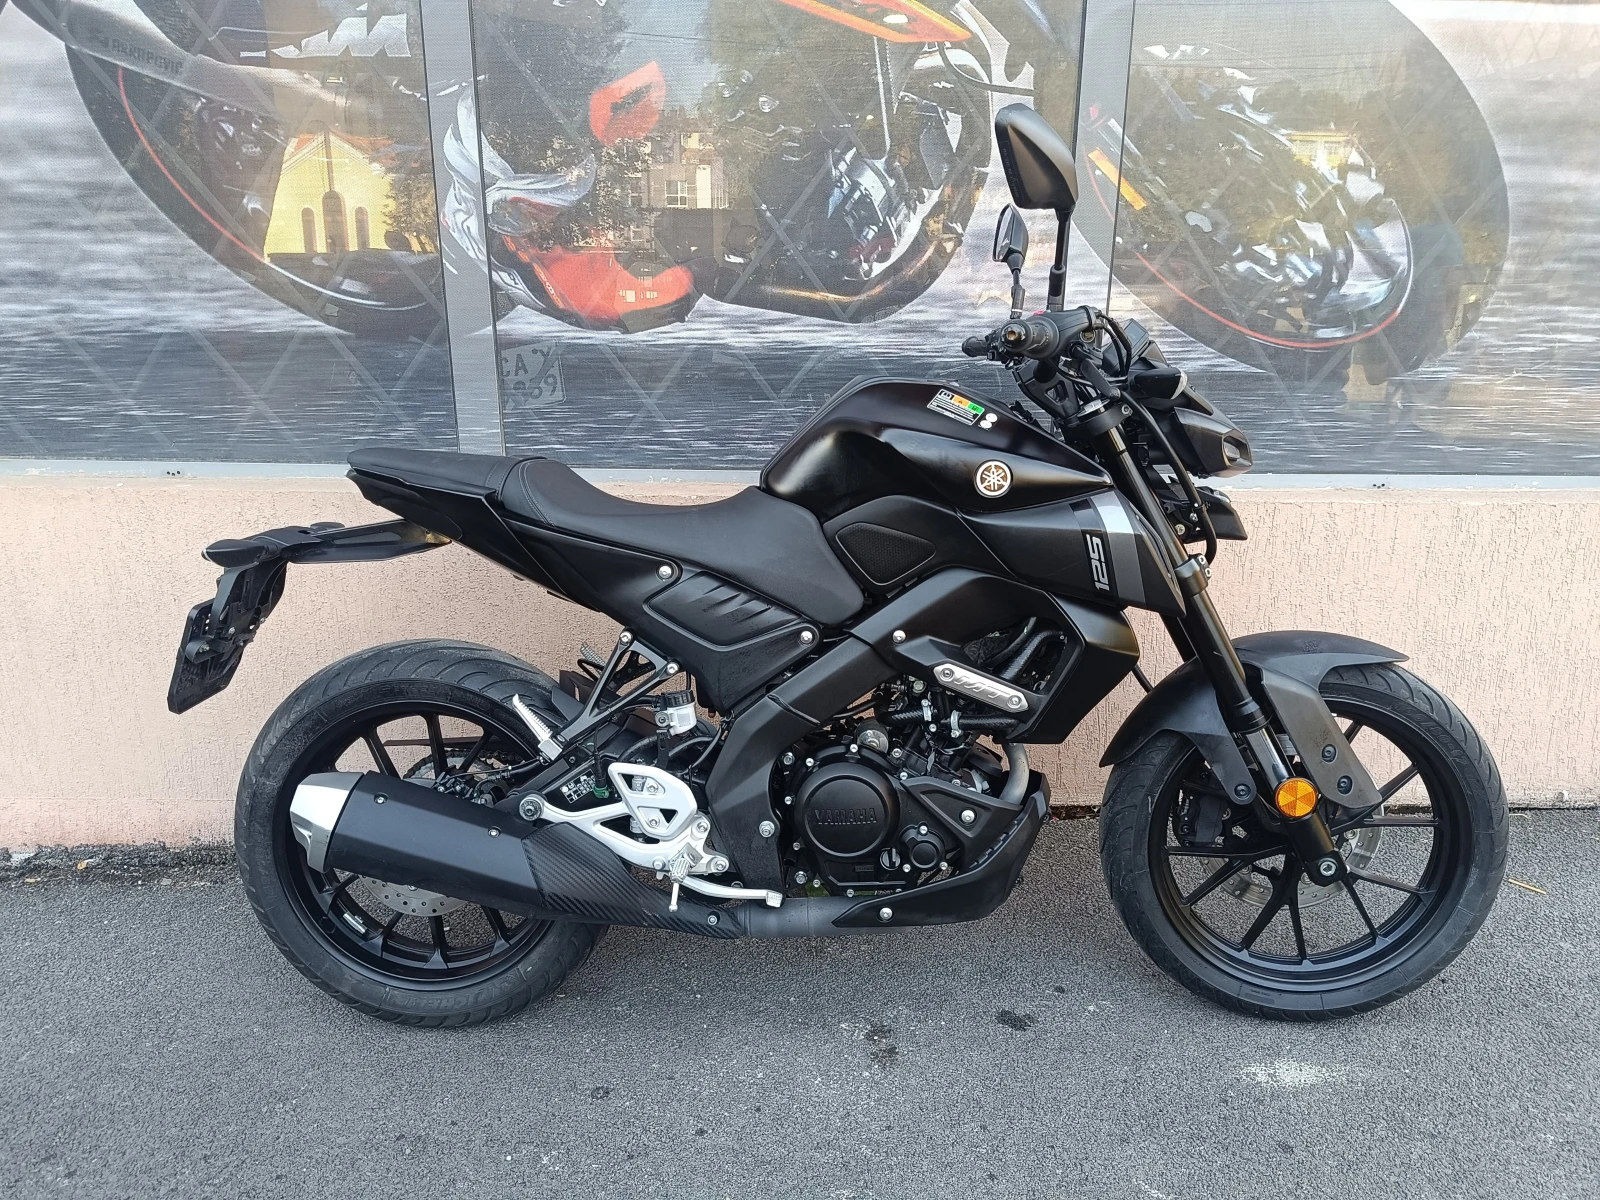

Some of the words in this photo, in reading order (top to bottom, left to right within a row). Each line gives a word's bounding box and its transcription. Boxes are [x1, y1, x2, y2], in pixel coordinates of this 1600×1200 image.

[1085, 533, 1110, 591] 125
[953, 675, 1011, 699] MT
[814, 807, 877, 825] YAMAHA
